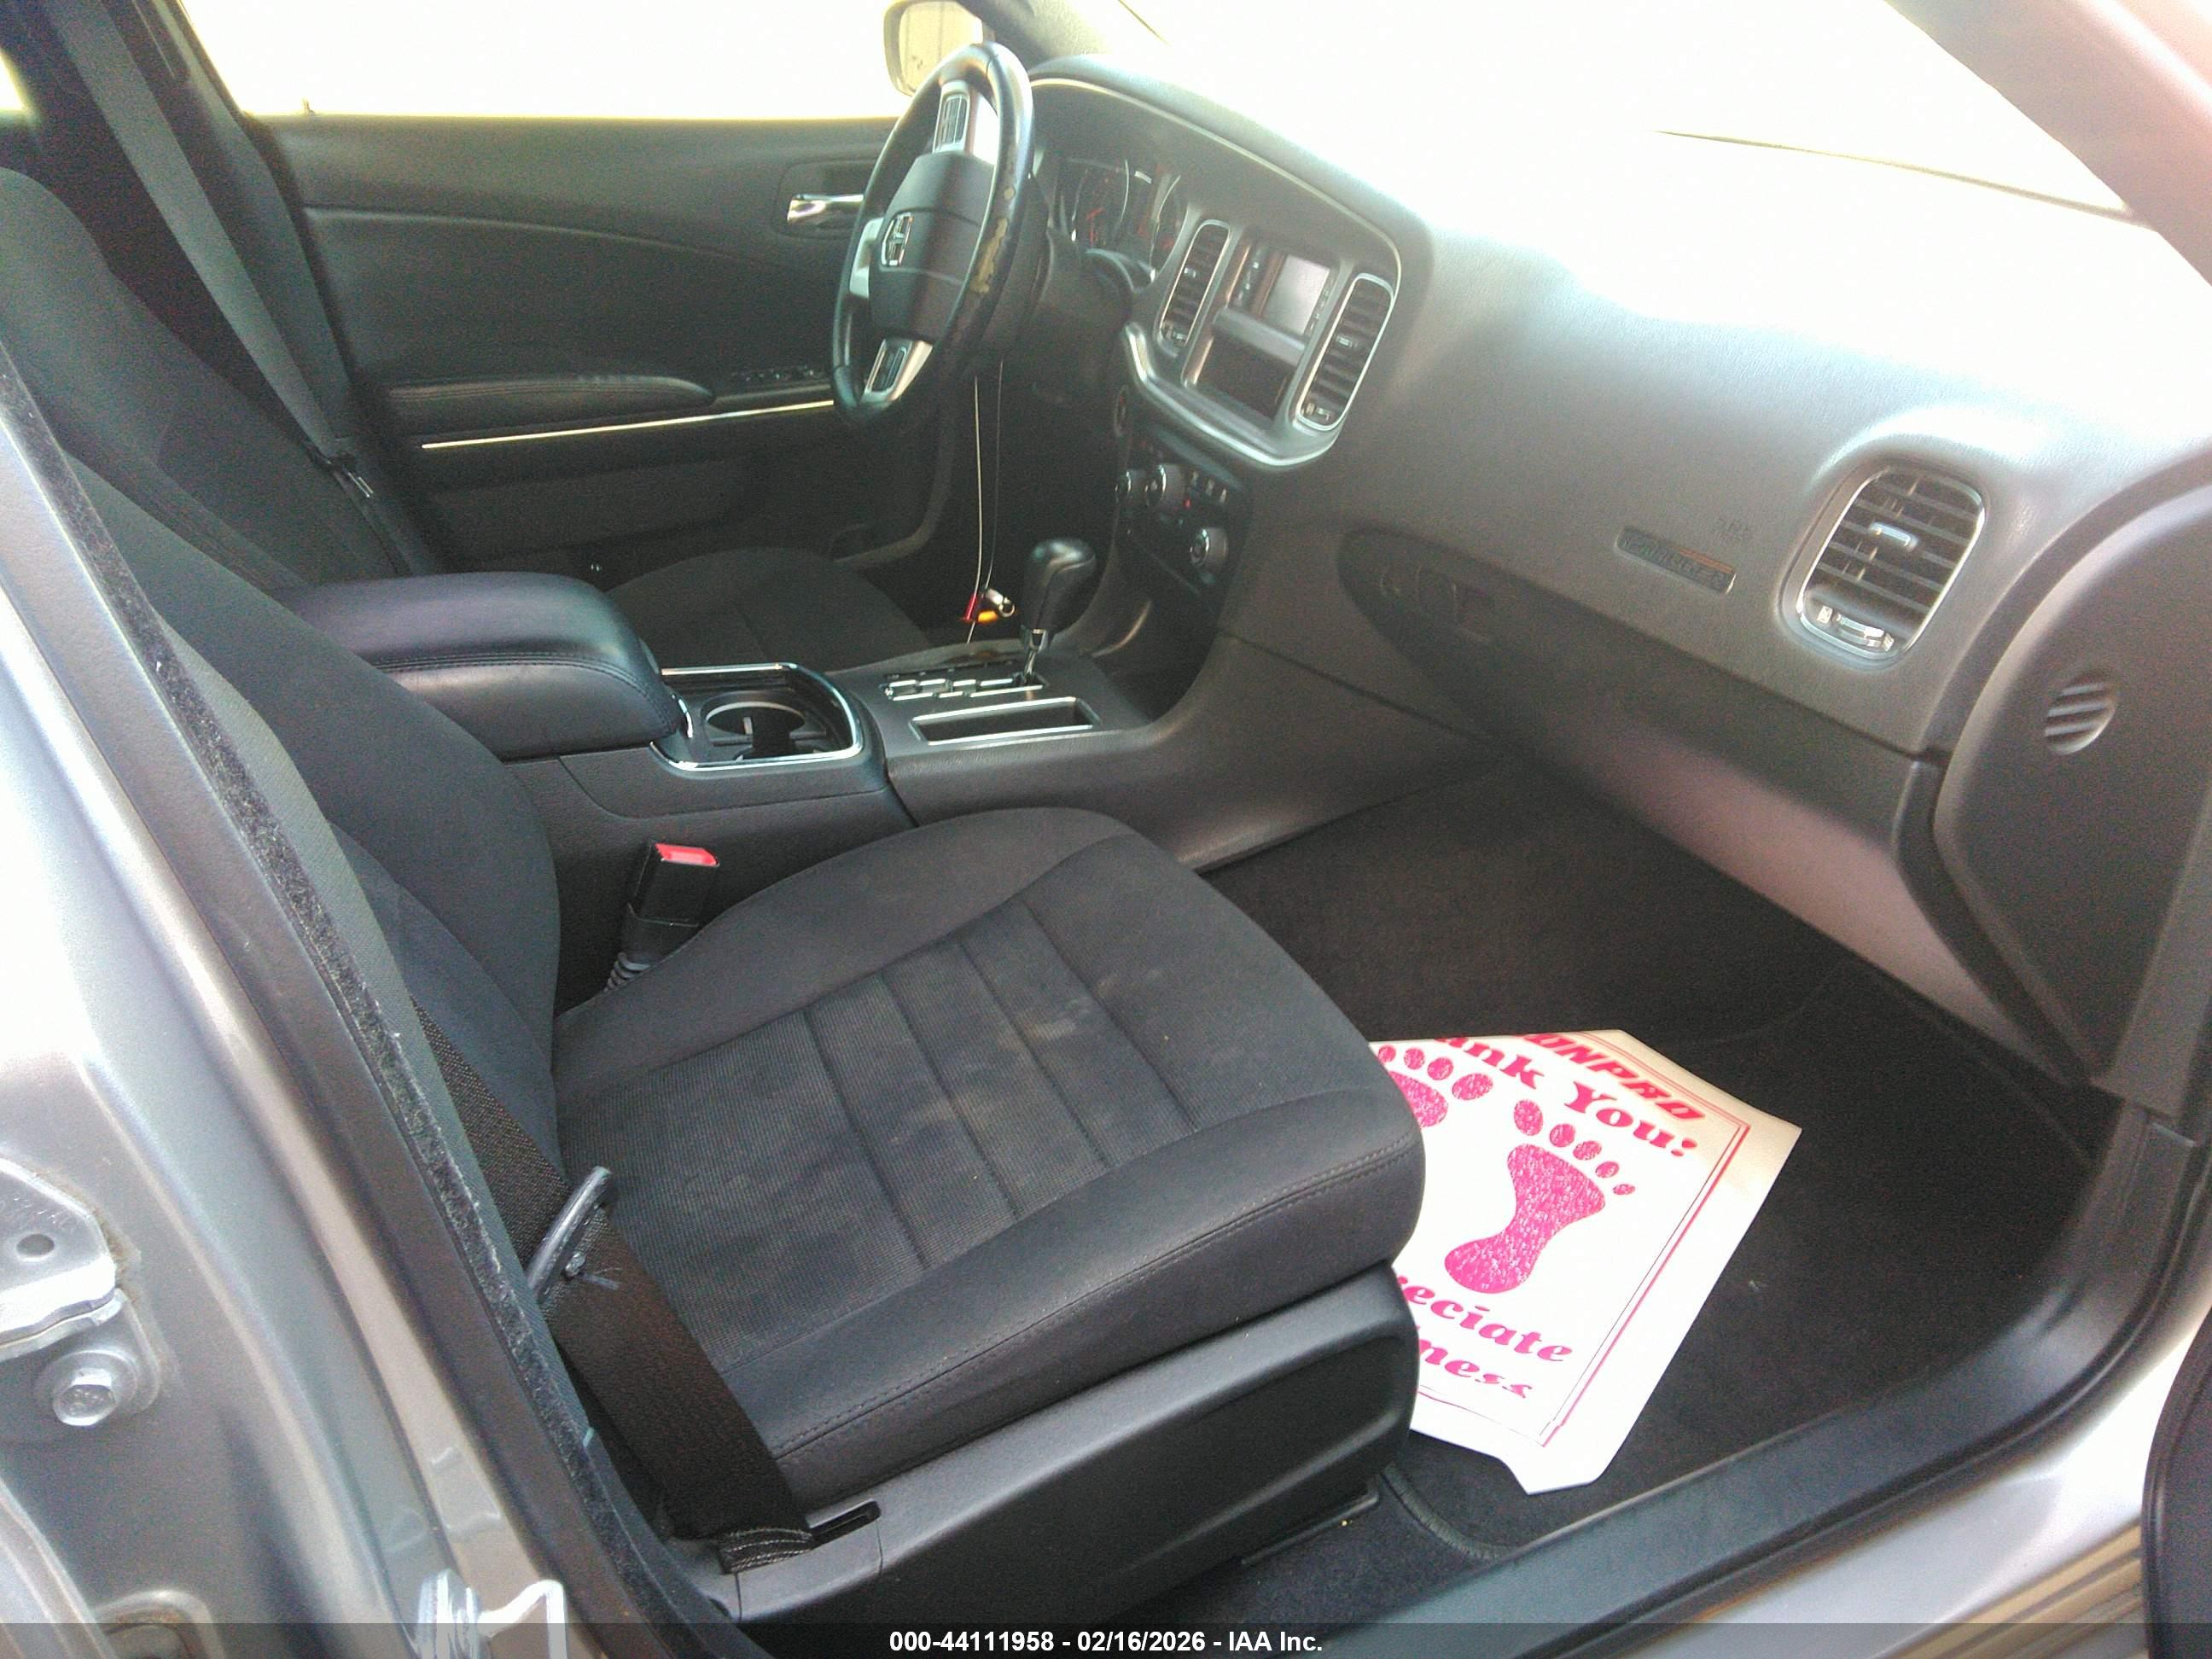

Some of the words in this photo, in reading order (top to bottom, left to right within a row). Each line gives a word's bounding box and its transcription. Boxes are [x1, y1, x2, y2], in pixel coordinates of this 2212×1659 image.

[1514, 1033, 1705, 1120] UNPRO
[1564, 1081, 1697, 1156] You!
[1397, 1276, 1573, 1361] eciate
[1417, 1339, 1533, 1399] ness
